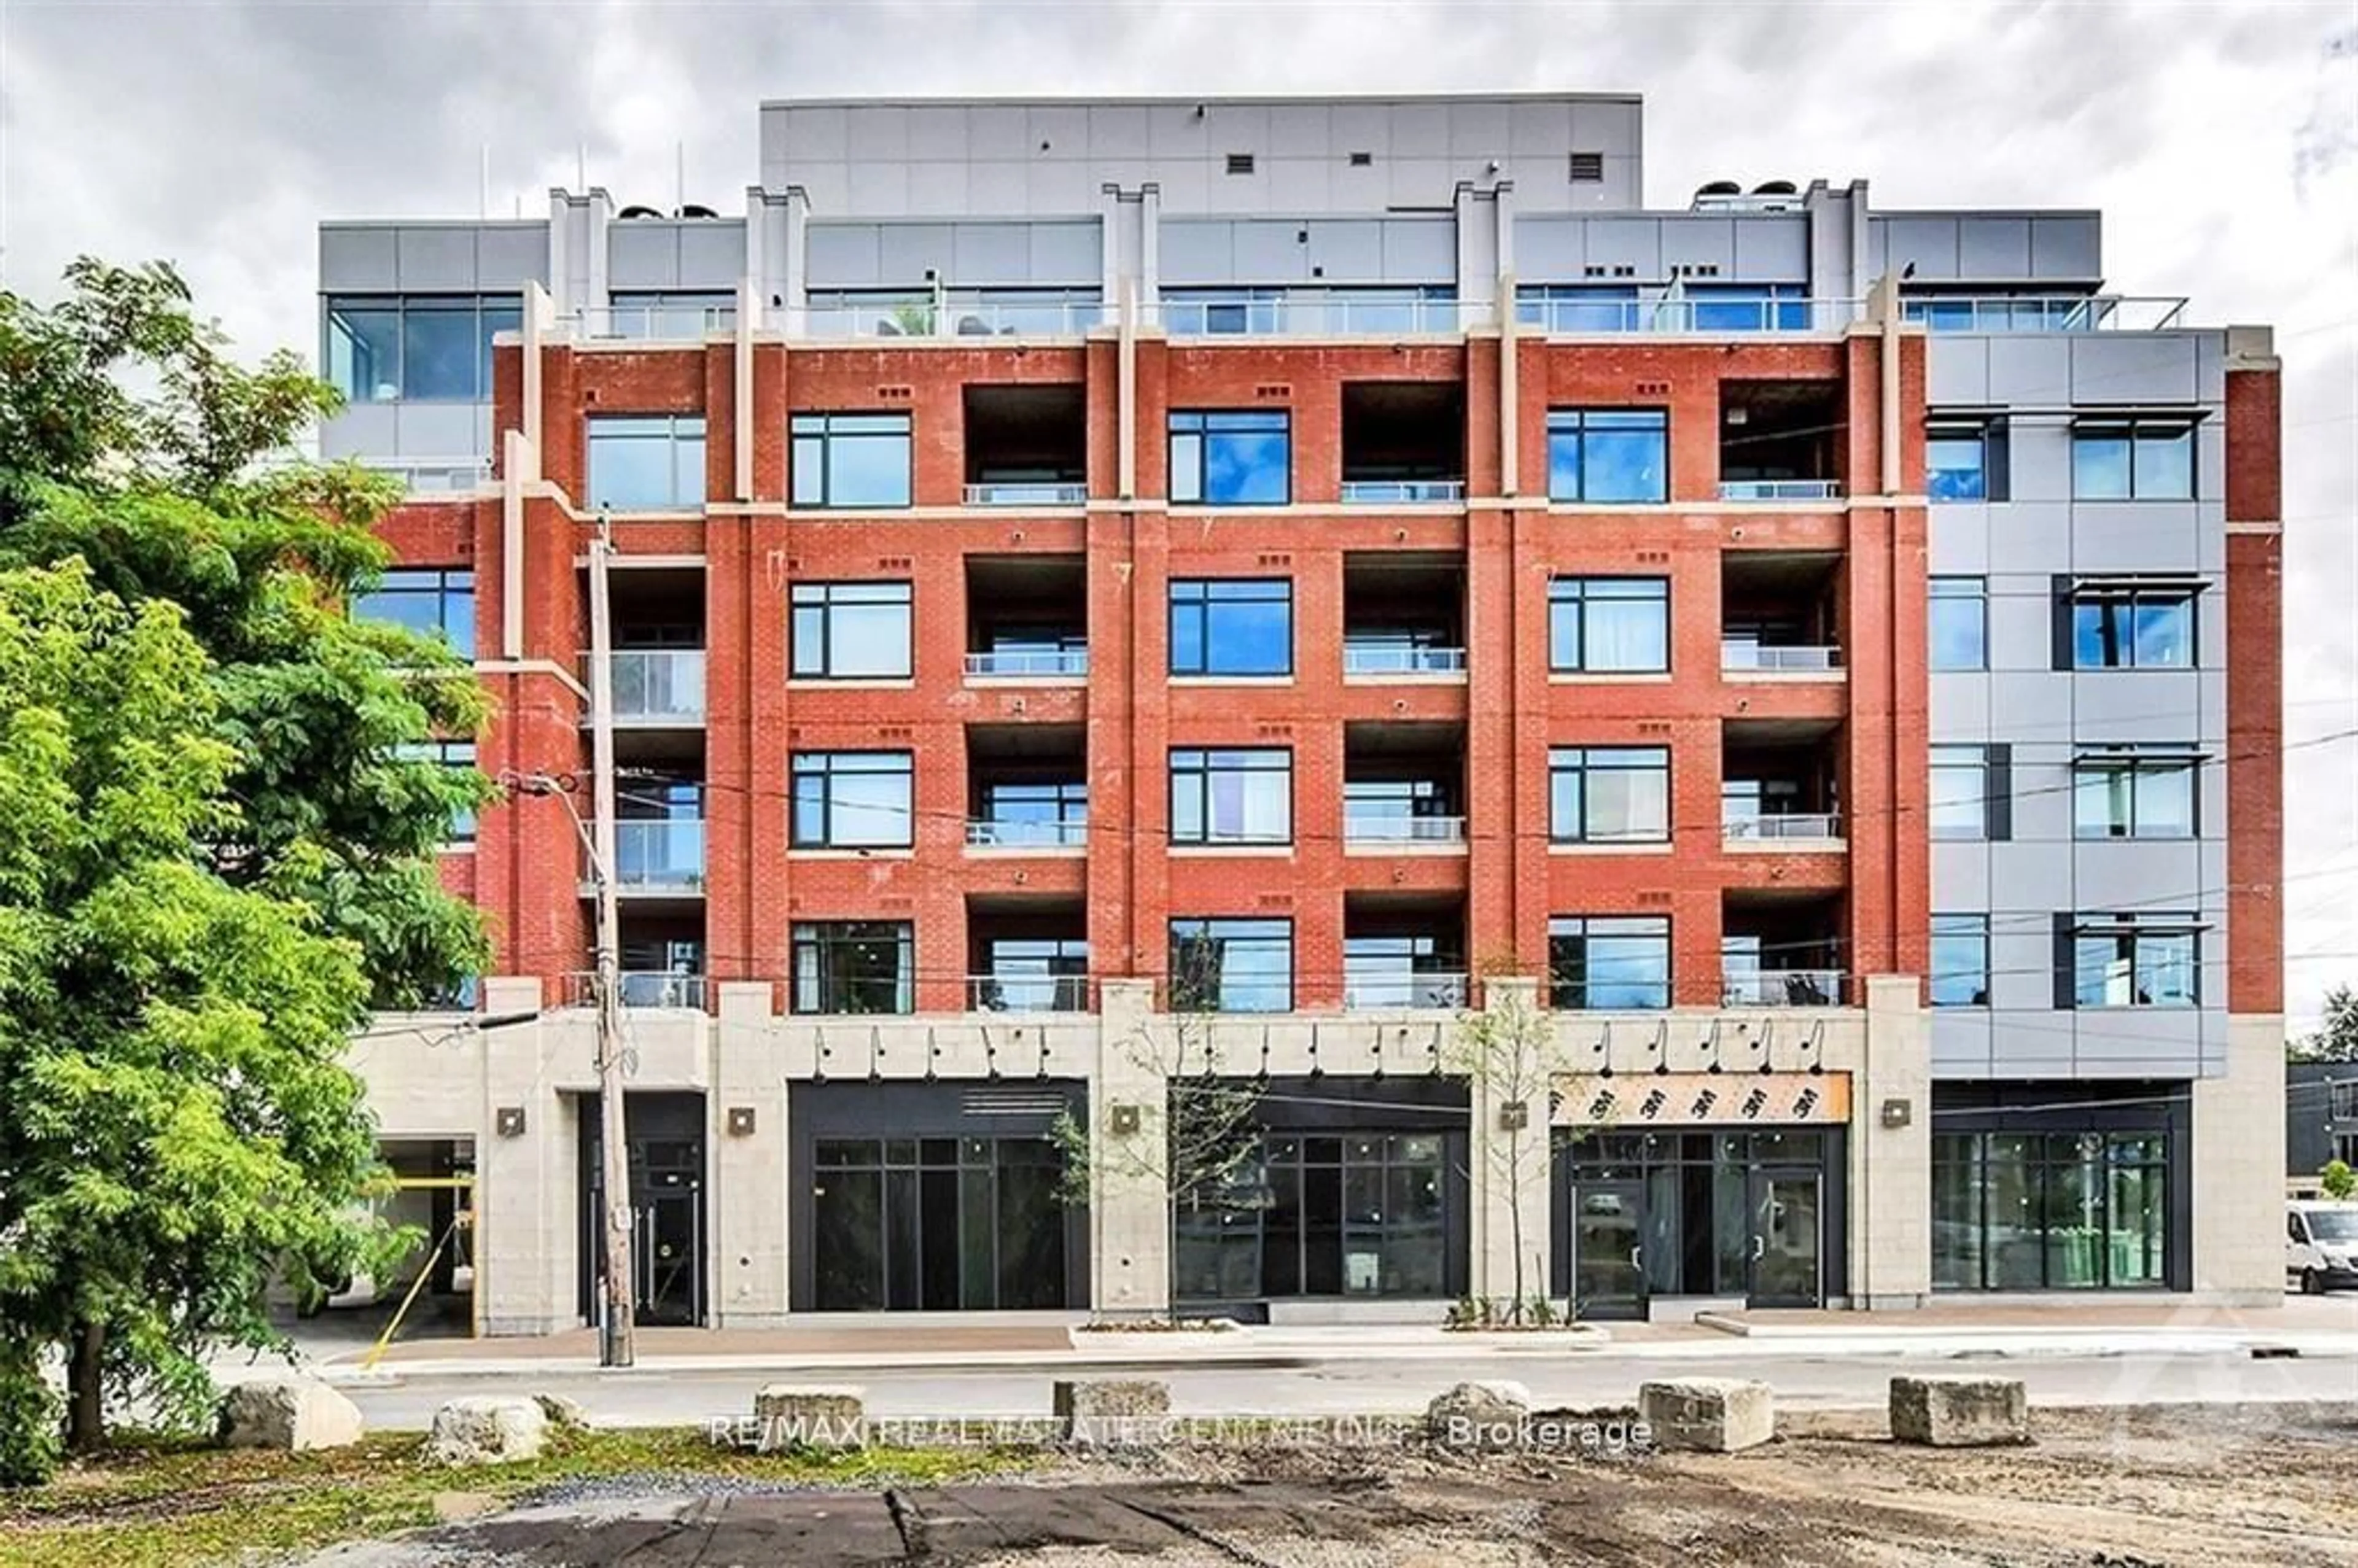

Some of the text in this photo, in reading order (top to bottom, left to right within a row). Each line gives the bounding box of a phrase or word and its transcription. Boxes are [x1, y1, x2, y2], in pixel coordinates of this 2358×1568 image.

[1640, 1089, 1666, 1119] 3M
[1691, 1089, 1717, 1119] 3M
[1741, 1088, 1767, 1119] 3M
[1793, 1087, 1818, 1119] 3M
